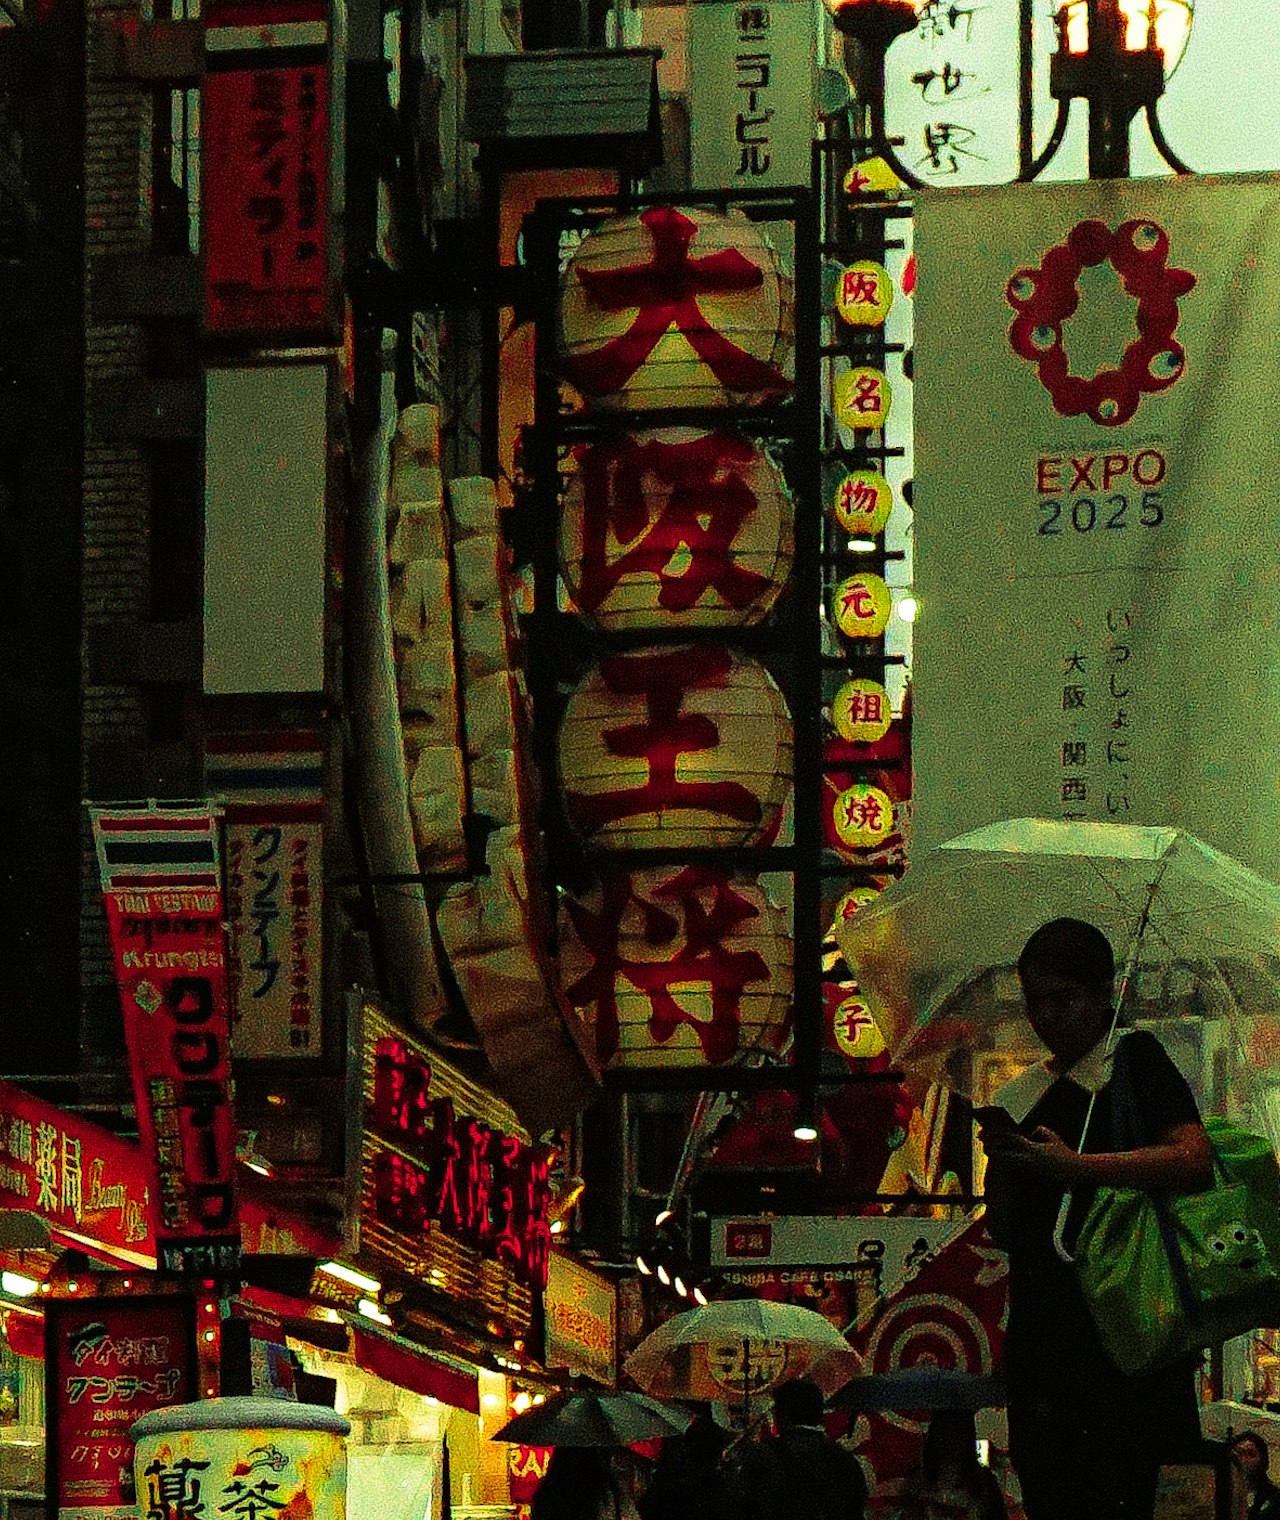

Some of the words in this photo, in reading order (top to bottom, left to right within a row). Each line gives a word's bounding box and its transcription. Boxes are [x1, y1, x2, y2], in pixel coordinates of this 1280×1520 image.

[1037, 449, 1166, 493] EXPO
[1038, 492, 1164, 535] 2025
[566, 204, 797, 1065] 大阪王将
[1062, 648, 1087, 821] 大阪・関西
[35, 1120, 82, 1225] 薬局
